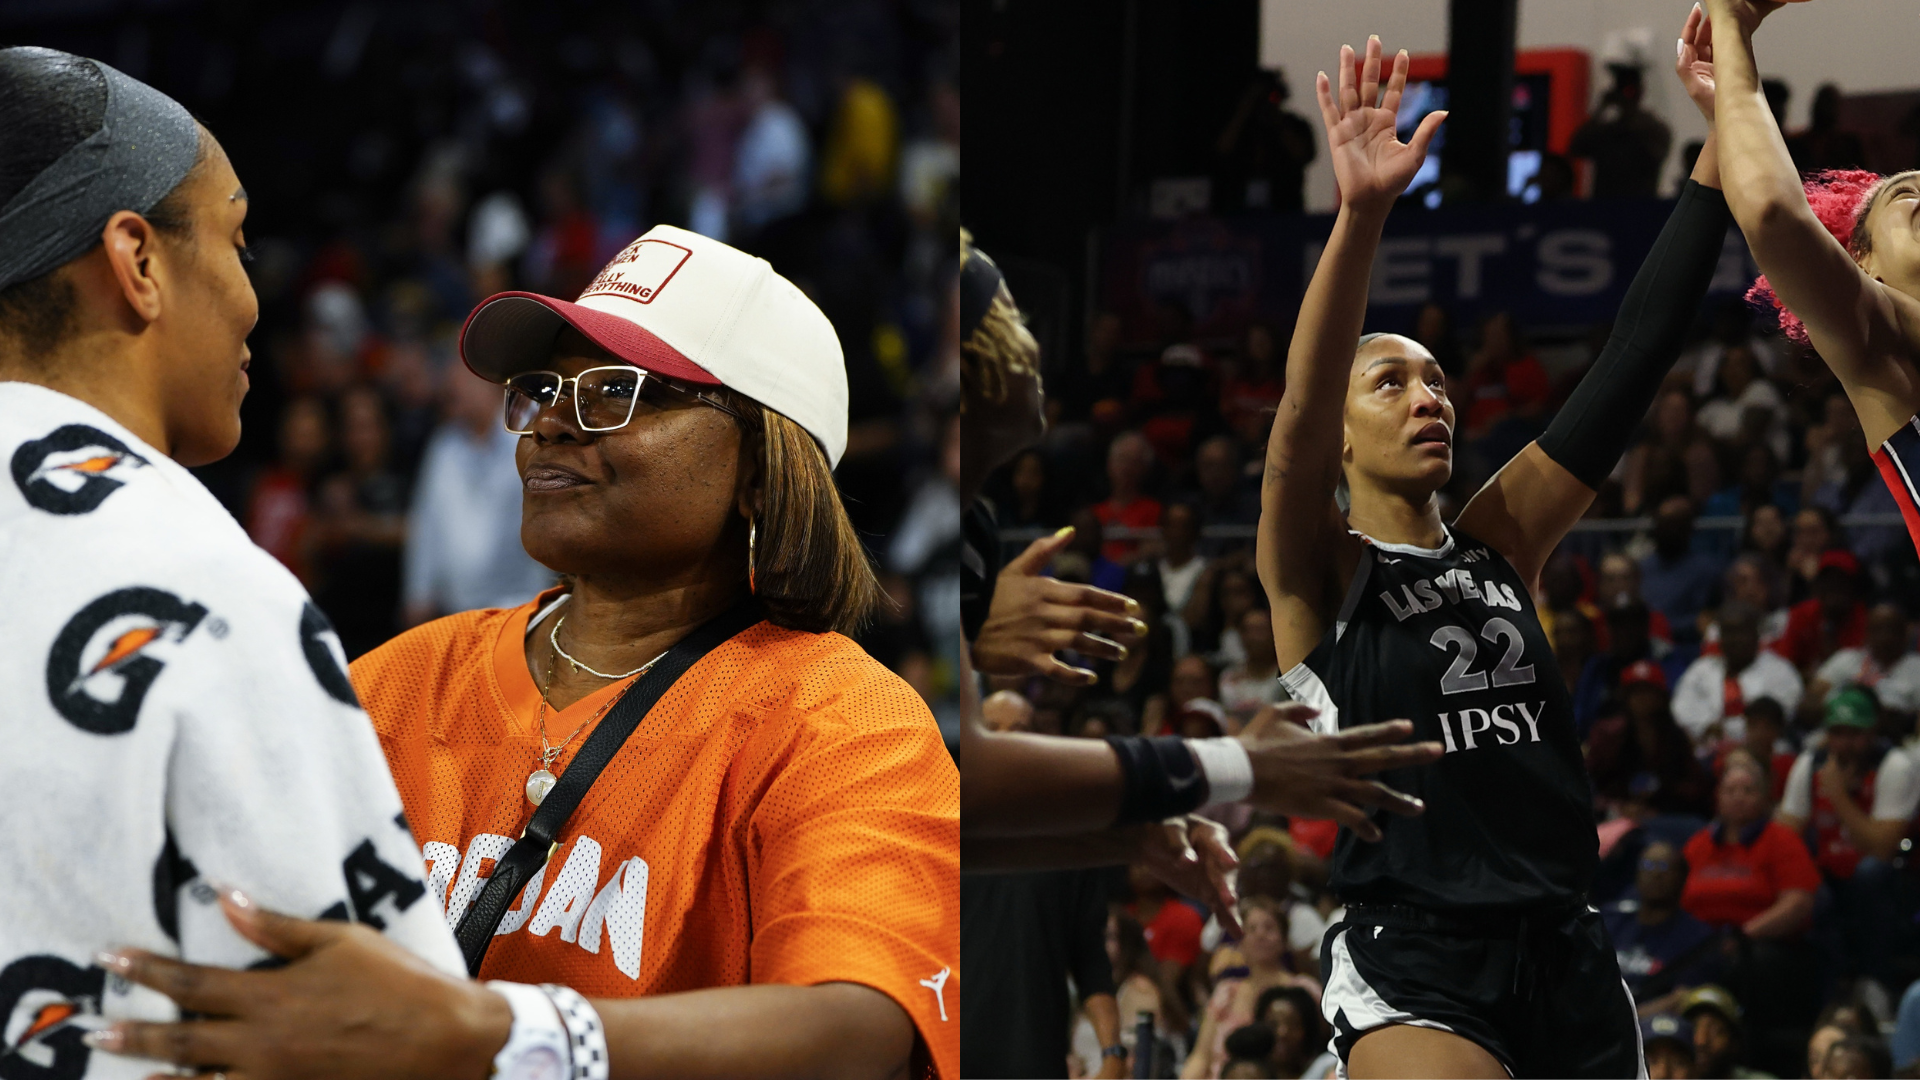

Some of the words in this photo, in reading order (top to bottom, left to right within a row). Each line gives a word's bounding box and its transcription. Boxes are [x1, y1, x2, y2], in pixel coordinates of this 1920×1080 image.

[1379, 578, 1443, 622] LAS
[1434, 568, 1523, 612] VEAS
[1429, 617, 1536, 695] 22
[1437, 700, 1547, 754] IPSY
